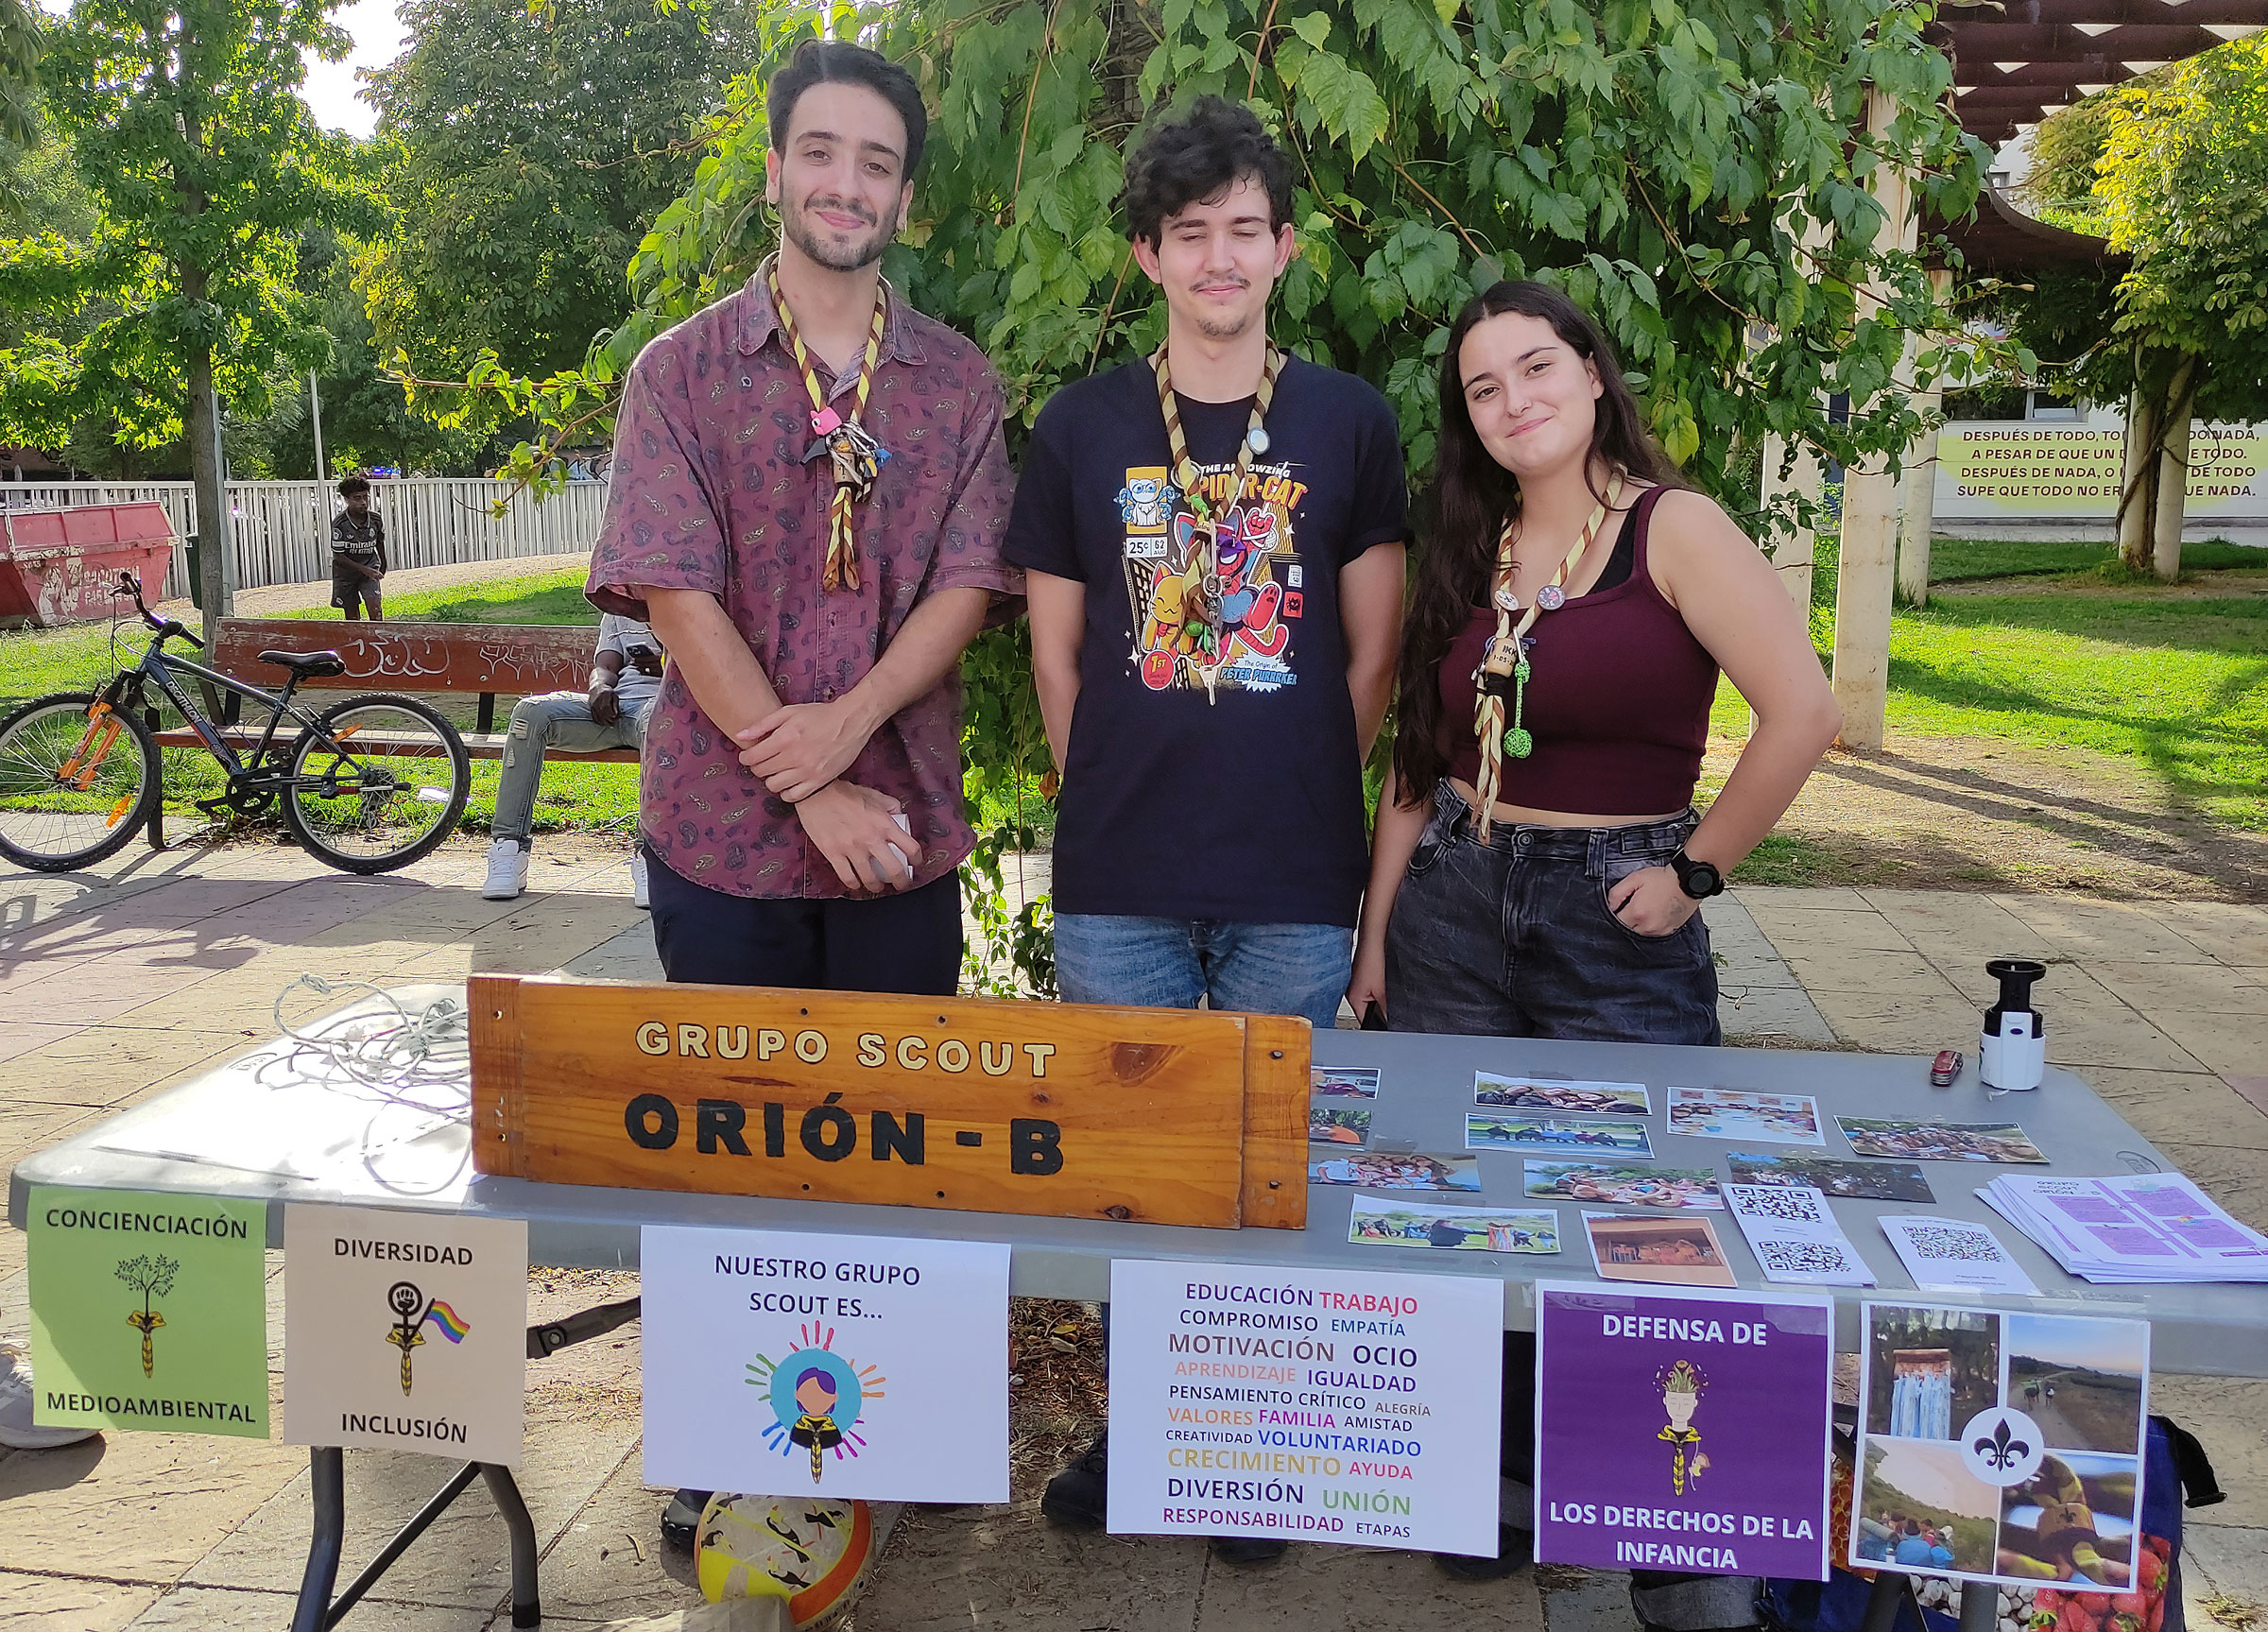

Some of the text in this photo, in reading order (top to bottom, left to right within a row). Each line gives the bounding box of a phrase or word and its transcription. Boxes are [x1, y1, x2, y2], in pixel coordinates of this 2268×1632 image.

[1963, 428, 2029, 441] DESPUÉS
[2033, 431, 2053, 441] DE
[2055, 431, 2099, 442] TODO,
[2102, 430, 2124, 441] TO
[2212, 429, 2259, 442] NADA,
[1201, 463, 1221, 472] THE
[1971, 449, 1982, 460] A
[1985, 449, 2032, 460] PESAR
[2036, 449, 2055, 460] DE
[2058, 449, 2089, 461] QUE
[2093, 449, 2115, 460] UN
[2203, 448, 2247, 459] TODO.
[1961, 465, 2028, 478] DESPUÉS
[2032, 467, 2051, 478] DE
[2054, 467, 2101, 480] NADA,
[2105, 467, 2115, 478] O
[2191, 466, 2210, 478] DE
[2215, 466, 2257, 478] TODO
[1957, 485, 2257, 498] SUPE QUE TODO NO ER UE NADA.
[1155, 540, 1165, 549] 62
[1220, 667, 1252, 680] PETER
[1255, 661, 1270, 669] Origin
[165, 680, 202, 724] DECATHLON
[635, 1020, 1057, 1078] GRUPO SCOUT
[624, 1091, 925, 1167] ORIÓN
[1010, 1117, 1065, 1177] B
[46, 1208, 248, 1240] CONCIENCIACIÓN
[334, 1238, 473, 1266] DIVERSIDAD
[714, 1255, 921, 1286] NUESTRO GRUPO
[749, 1292, 883, 1319] SCOUT ES...
[1186, 1282, 1418, 1318] EDUCACIÓN TRABAJO
[1179, 1309, 1406, 1337] COMPROMISO EMPATÍA
[1602, 1314, 1767, 1347] DEFENSA DE
[1168, 1332, 1418, 1367] MOTIVACIÓN OCIO
[1175, 1361, 1417, 1394] APRENDIZAJE IGUALDAD
[47, 1392, 256, 1423] MEDIOAMBIENTAL
[1169, 1384, 1432, 1417] PENSAMIENTO CRÍTICO ALEGRÍA
[341, 1411, 469, 1445] INCLUSIÓN
[1167, 1407, 1413, 1433] VALORES FAMILIA AMISTAD
[1165, 1429, 1421, 1457] CREATIVIDAD VOLUNTARIADO
[1167, 1447, 1413, 1481] CRECIMIENTO AYUDA
[1167, 1476, 1411, 1516] DIVERSIÓN UNIÓN
[1162, 1507, 1411, 1538] RESPONSABILIDAD ETAPAS
[1550, 1501, 1814, 1540] LOS DERECHOS DE LA
[1616, 1540, 1739, 1570] INFANCIA
